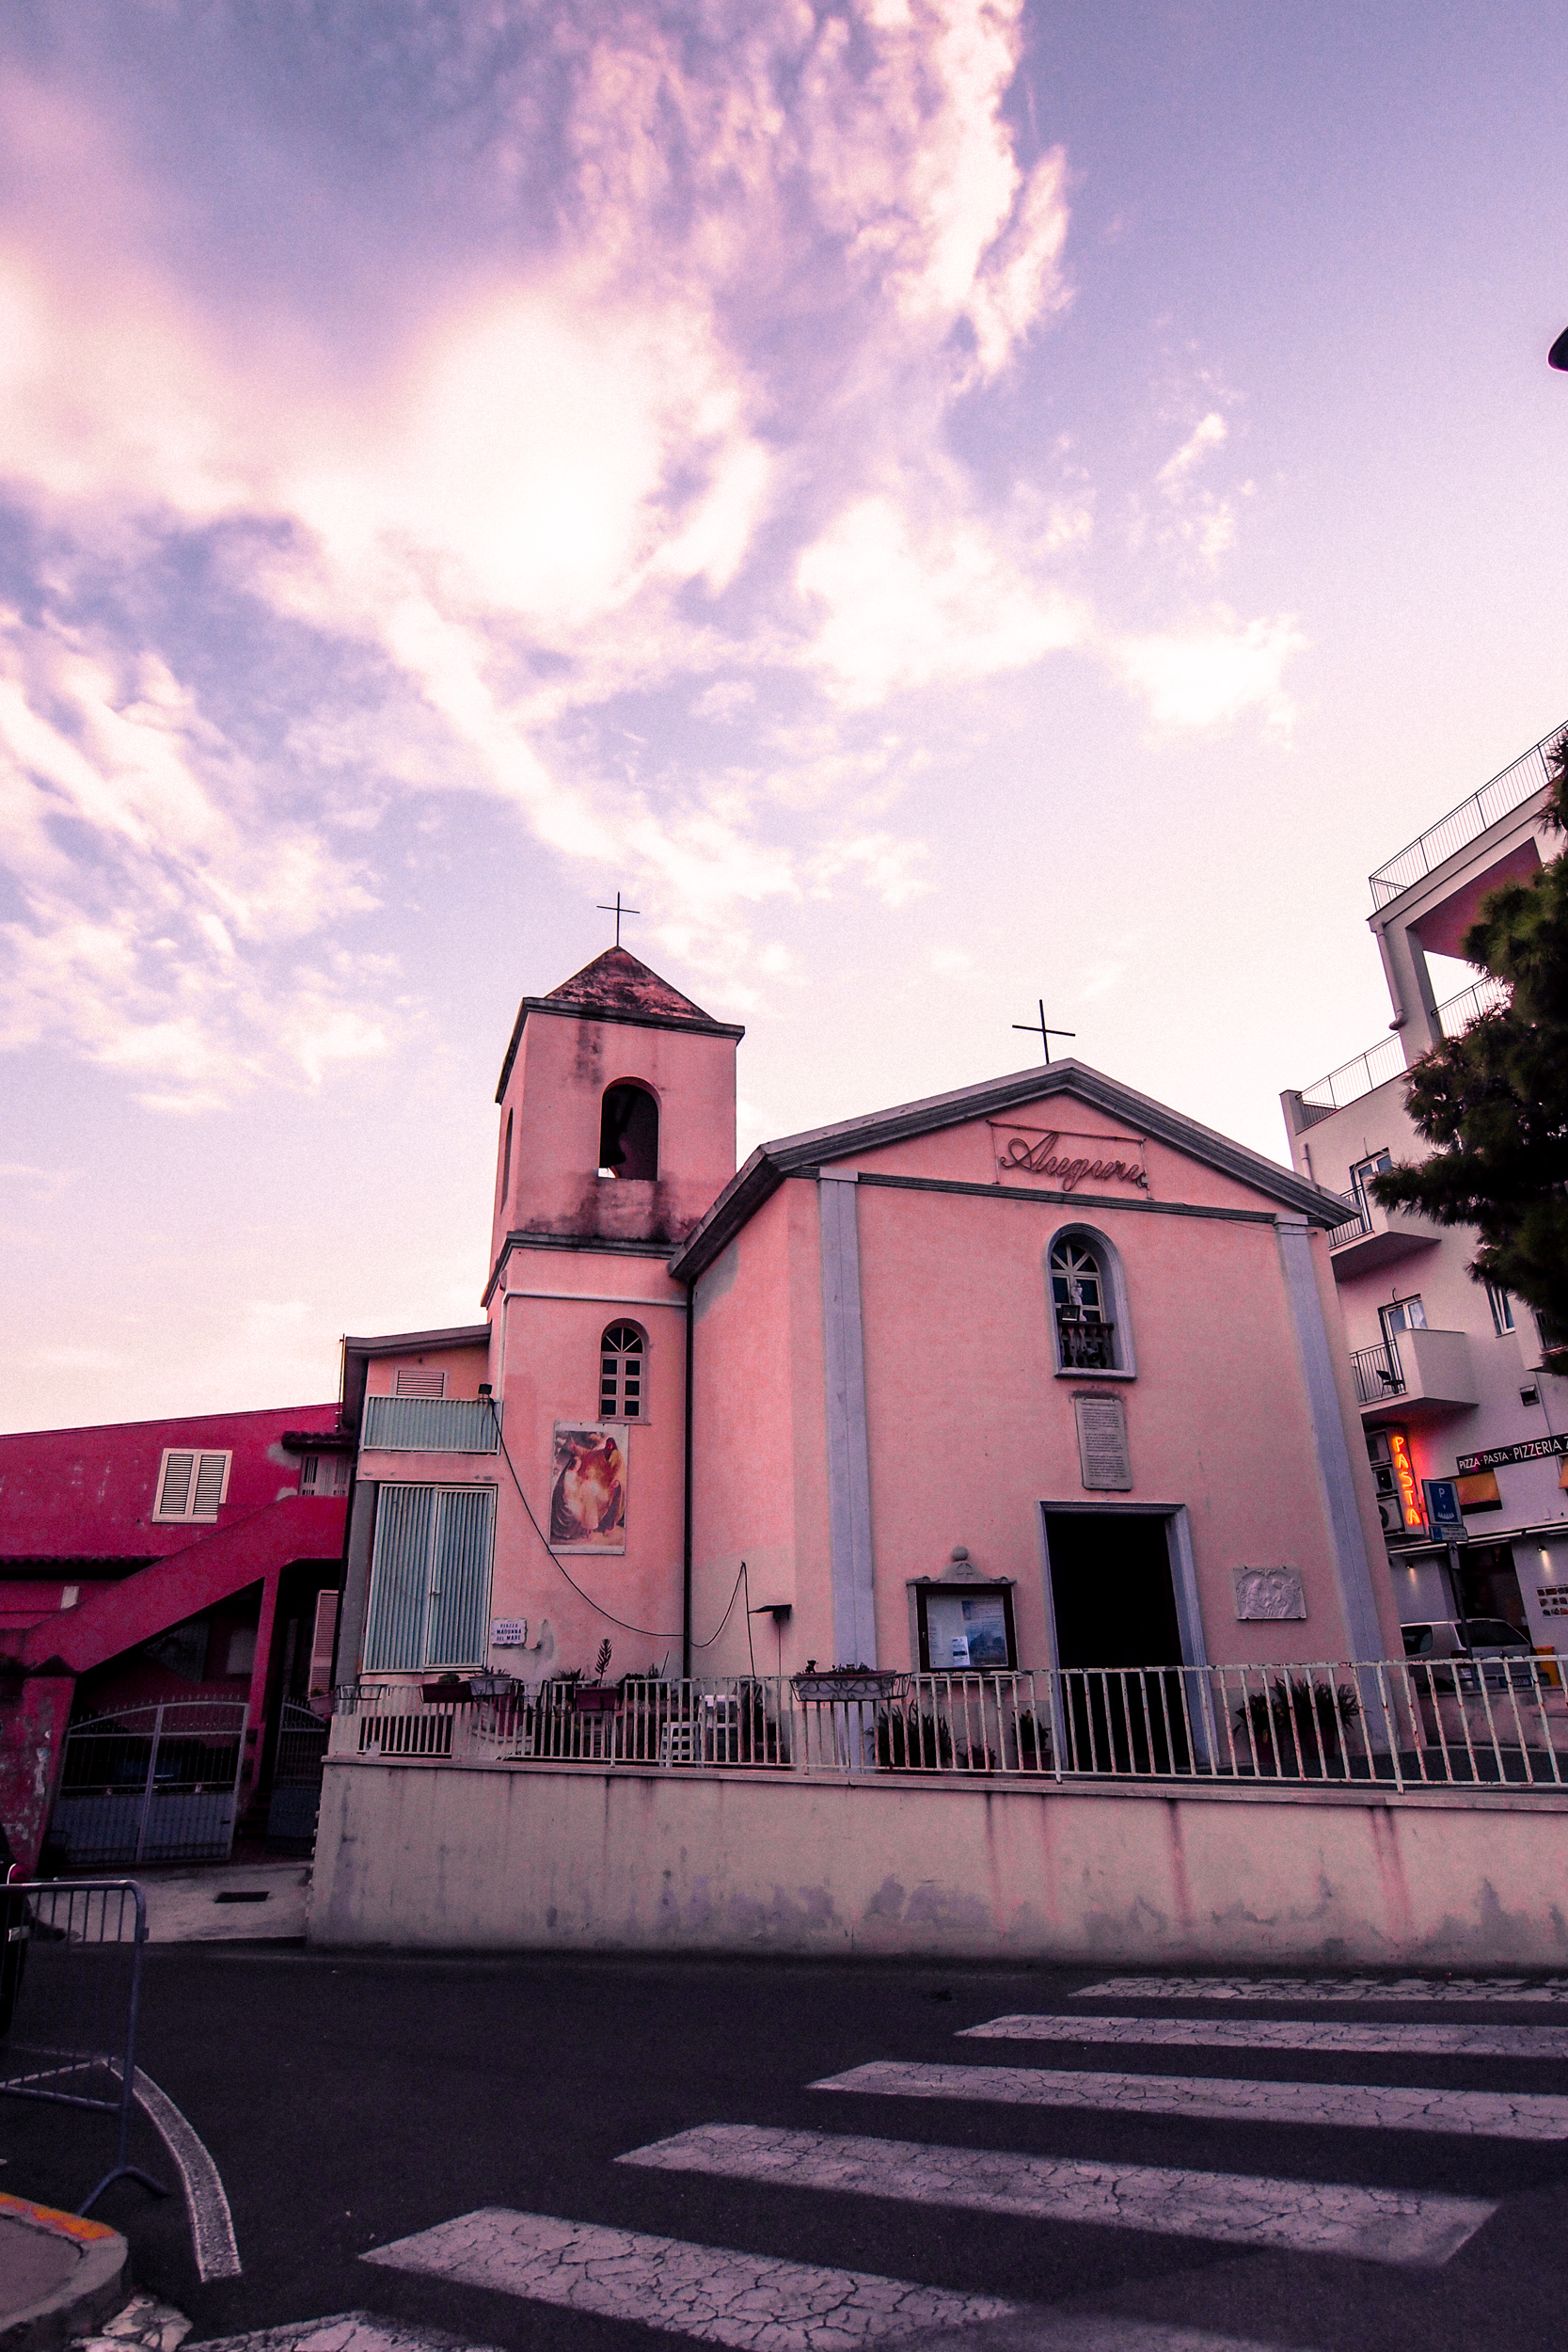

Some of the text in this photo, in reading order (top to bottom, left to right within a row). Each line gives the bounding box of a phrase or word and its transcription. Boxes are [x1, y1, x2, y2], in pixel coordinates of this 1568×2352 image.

[1459, 1457, 1481, 1470] PIZZA
[1483, 1452, 1510, 1465] PASTA
[1513, 1438, 1563, 1460] PIZZERIA
[1393, 1436, 1421, 1525] PASTA
[1438, 1487, 1446, 1499] P
